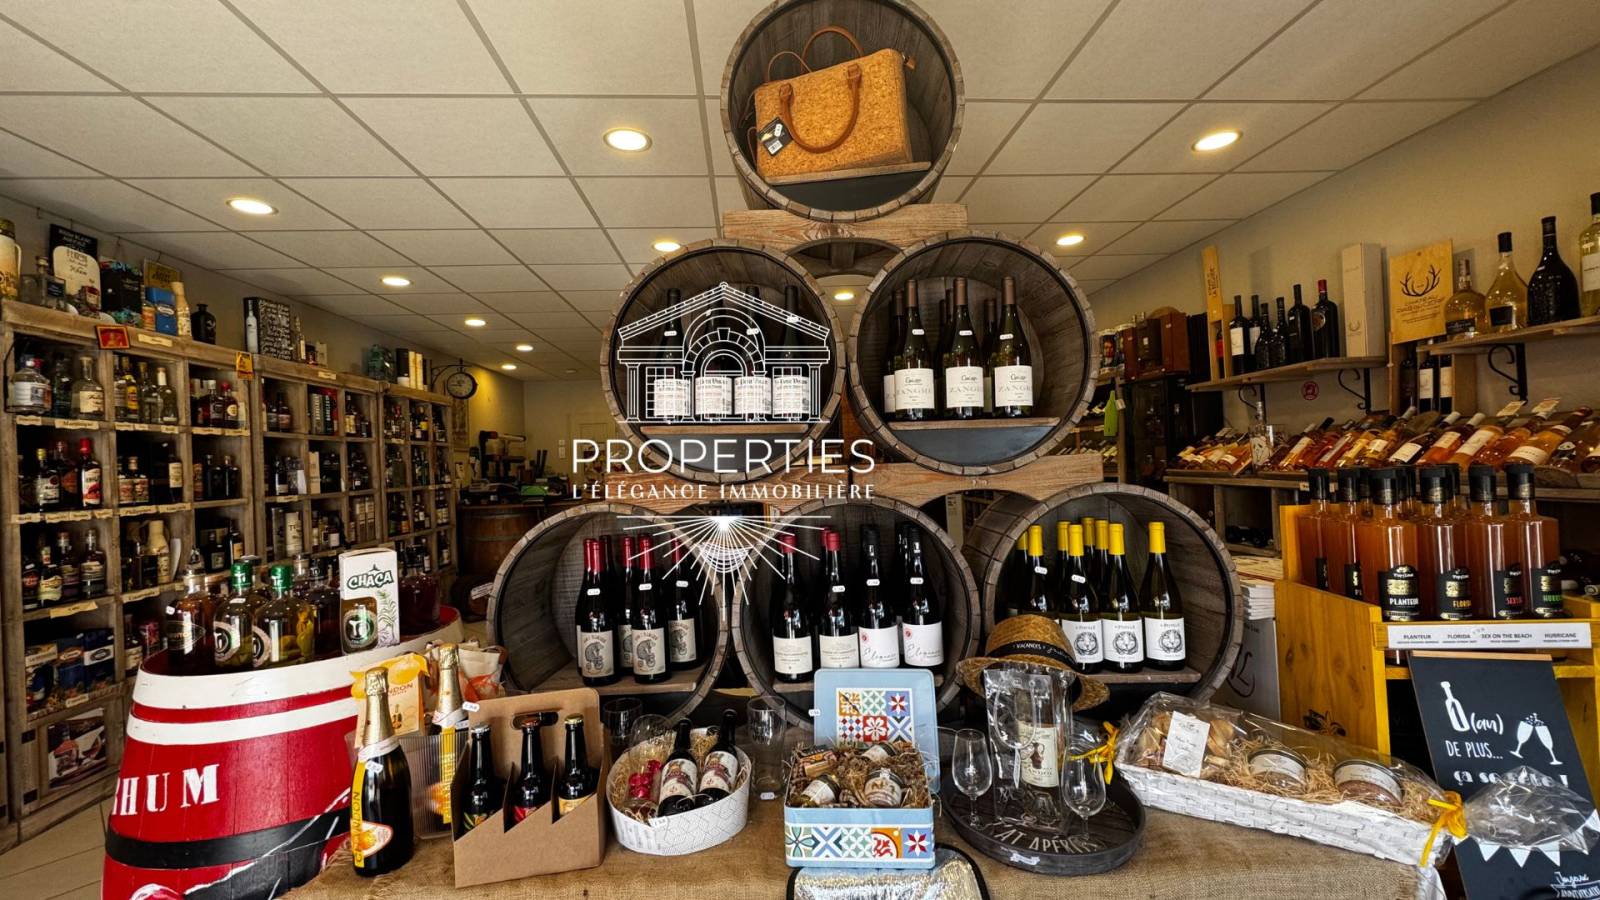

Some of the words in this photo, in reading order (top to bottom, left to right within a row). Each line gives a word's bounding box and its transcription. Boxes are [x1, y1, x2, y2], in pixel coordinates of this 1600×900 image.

[1445, 740, 1462, 757] DE
[1465, 742, 1504, 760] PLUS...
[1453, 770, 1473, 786] ça
